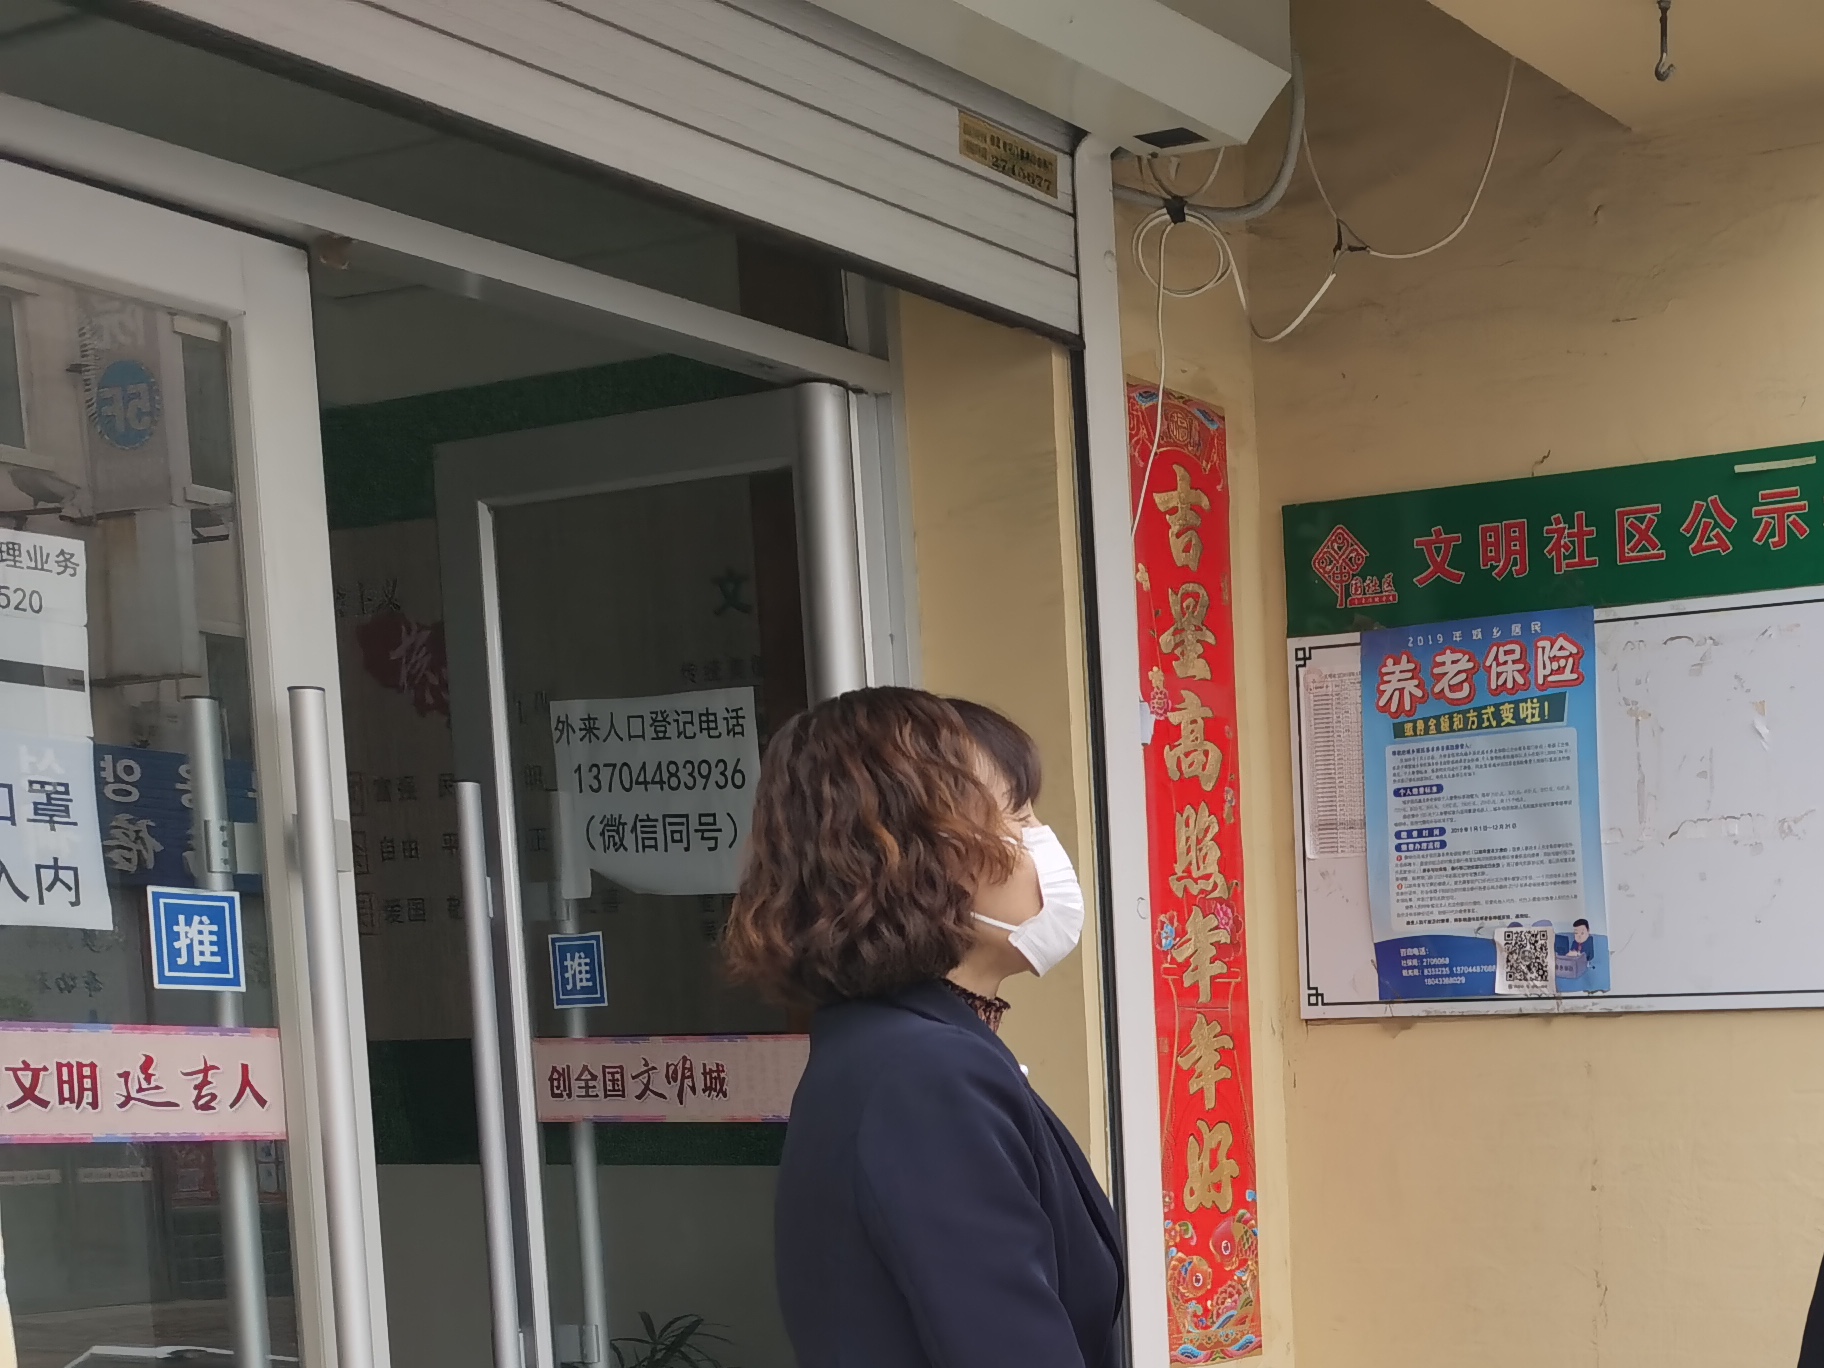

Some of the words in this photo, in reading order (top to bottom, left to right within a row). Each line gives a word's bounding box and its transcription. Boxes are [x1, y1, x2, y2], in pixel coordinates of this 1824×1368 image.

[1378, 634, 1582, 715] 养老保险
[553, 706, 747, 746] 外来人口登记电话
[573, 757, 746, 794] 13704483936
[585, 811, 738, 854] （微信同号）
[172, 913, 221, 966] 推
[563, 951, 593, 991] 推
[4, 1053, 269, 1111] 文明延吉人
[548, 1054, 728, 1105] 创全国文明城
